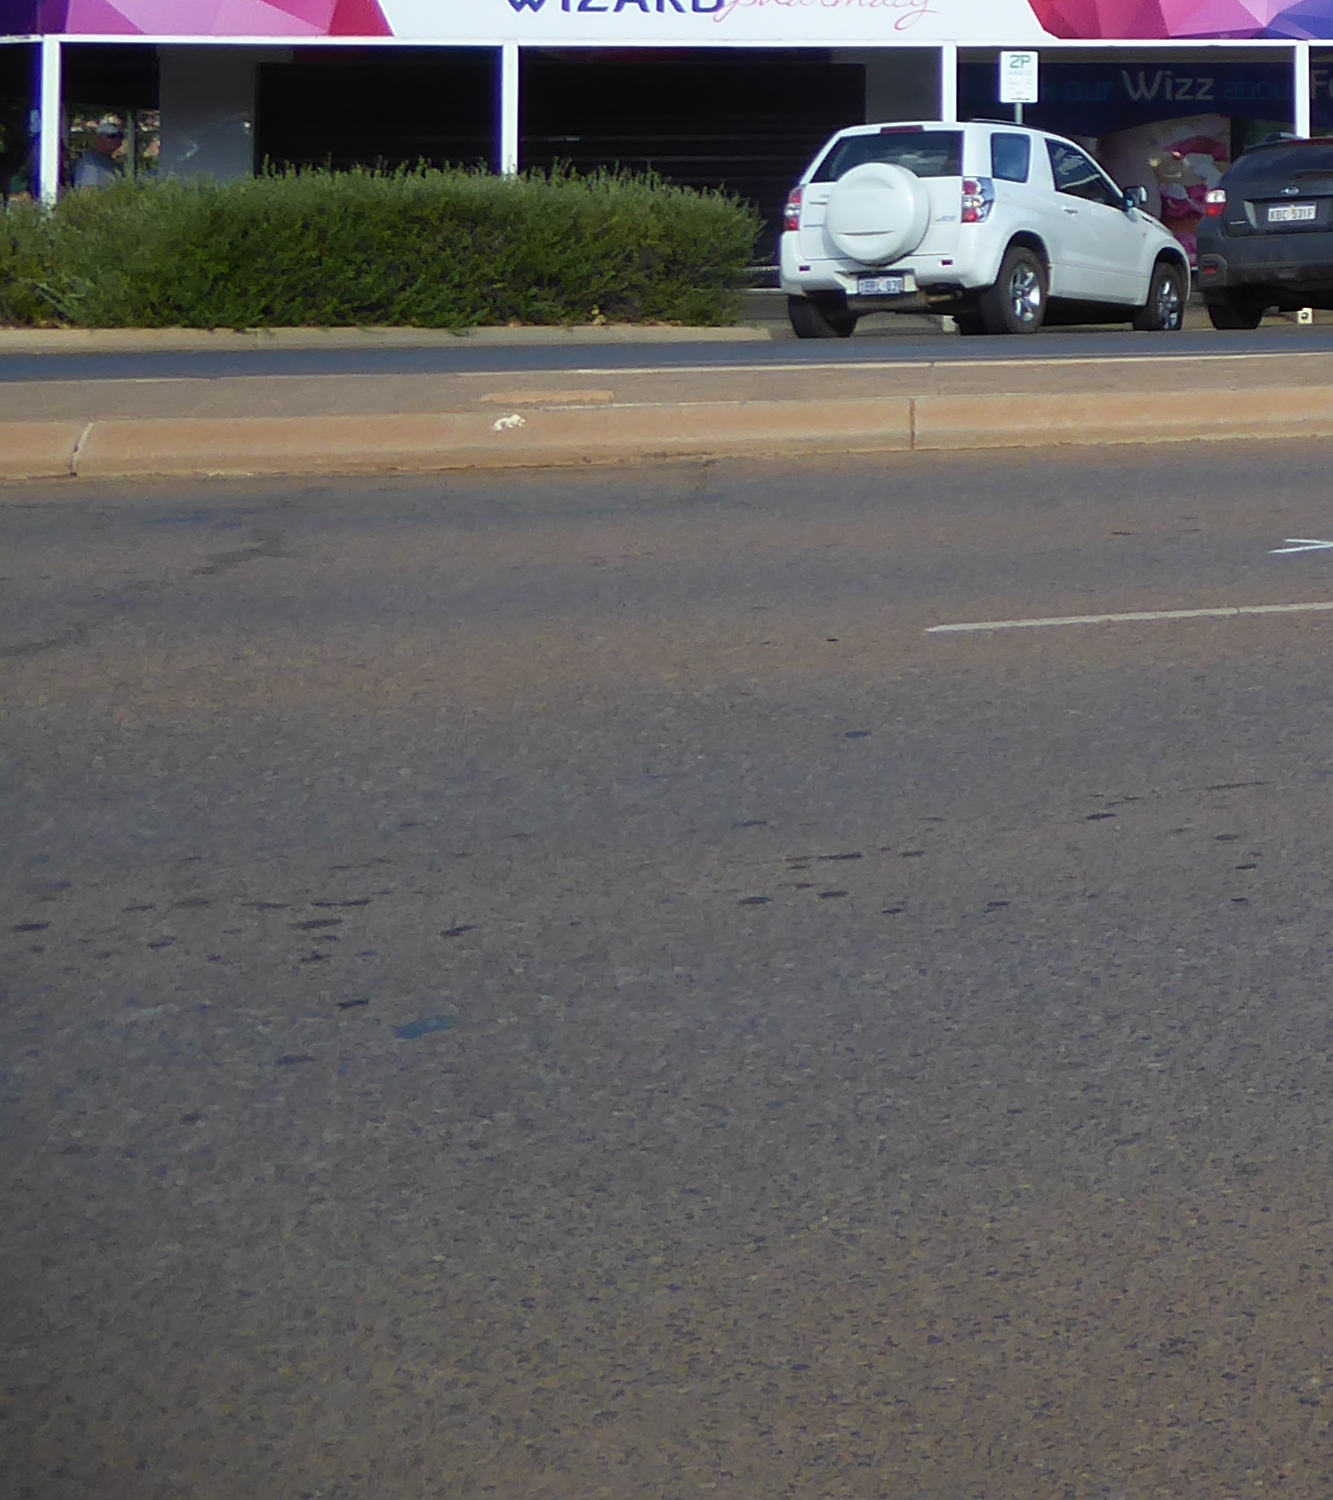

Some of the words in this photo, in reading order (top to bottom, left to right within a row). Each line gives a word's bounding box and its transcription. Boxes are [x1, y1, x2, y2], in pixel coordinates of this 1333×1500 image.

[1009, 54, 1032, 69] 2P
[1120, 68, 1215, 101] Wizz
[1223, 74, 1294, 101] abou
